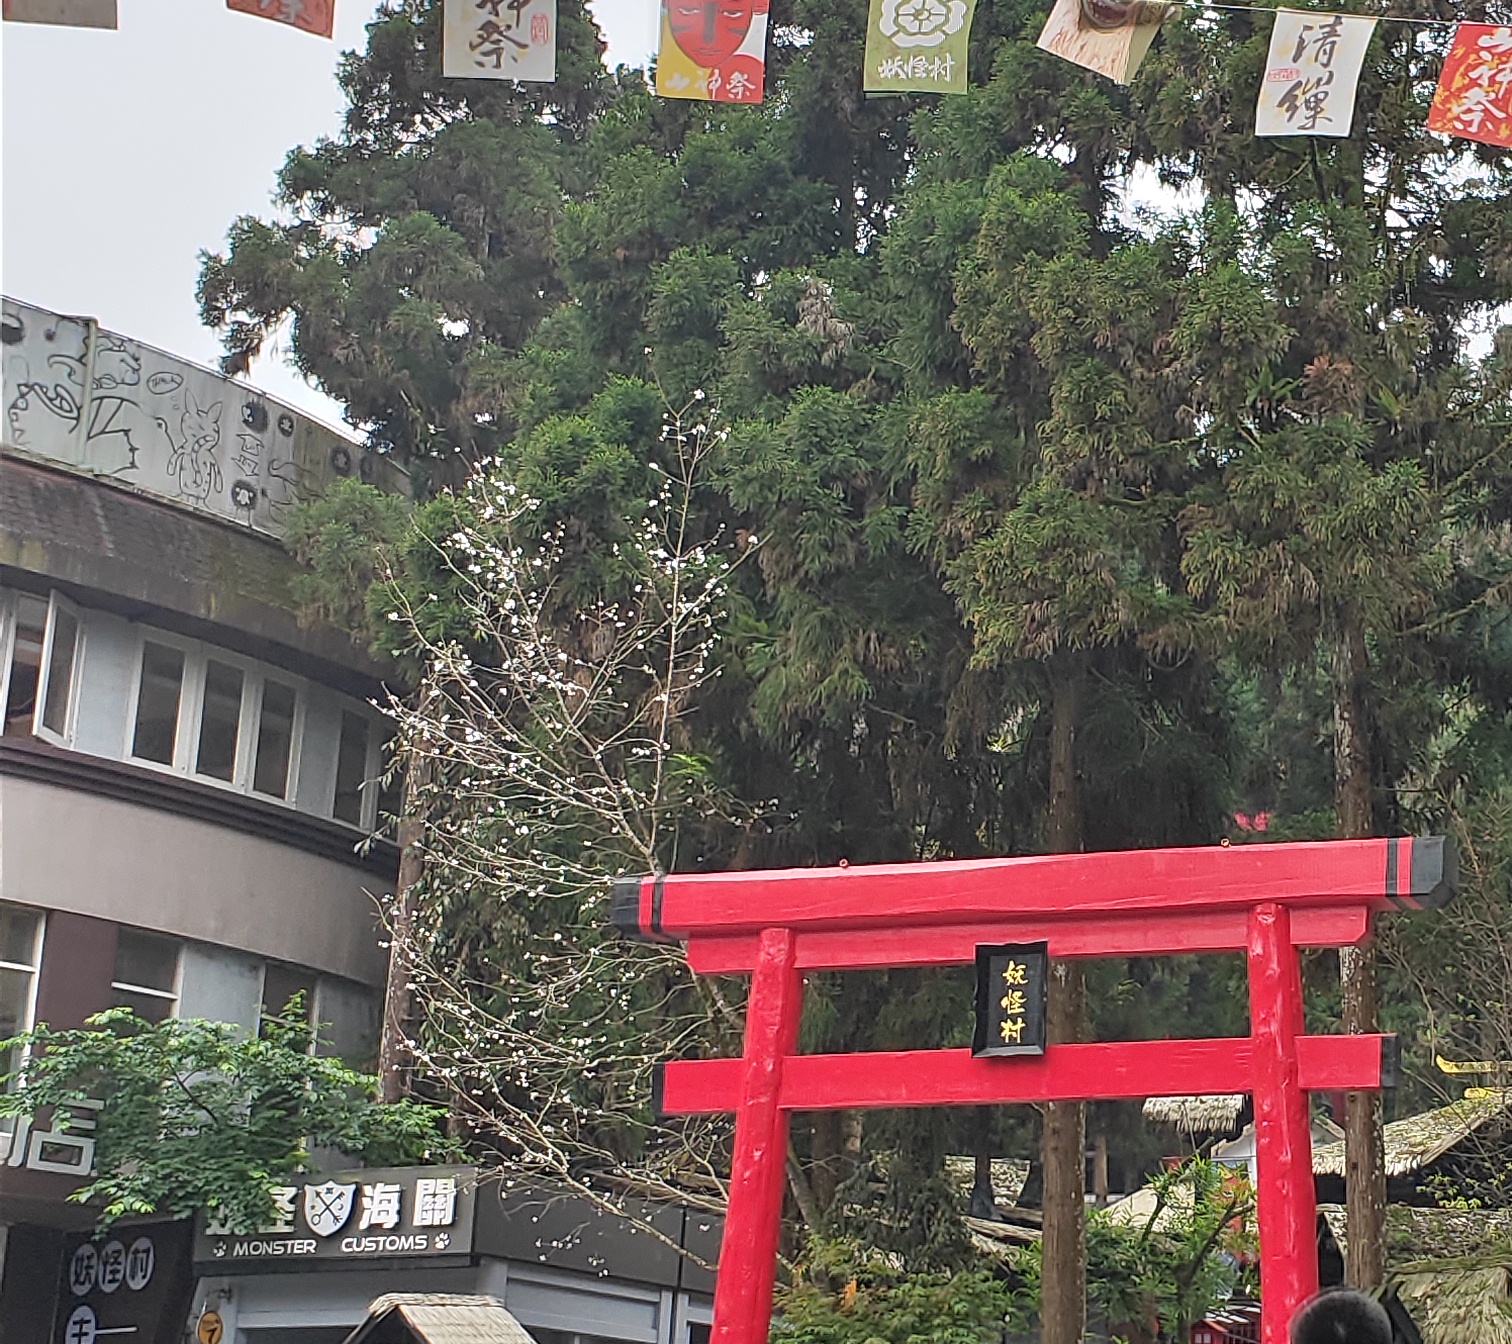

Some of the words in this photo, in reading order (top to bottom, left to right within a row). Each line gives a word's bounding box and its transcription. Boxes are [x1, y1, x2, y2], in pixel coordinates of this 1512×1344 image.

[877, 54, 957, 84] 妖怪村
[1000, 960, 1029, 1044] 妖怪村
[359, 1177, 458, 1231] 海關
[232, 1239, 318, 1257] MONSTER
[341, 1234, 429, 1253] CUSTOMS
[74, 1246, 151, 1287] 妖怪村
